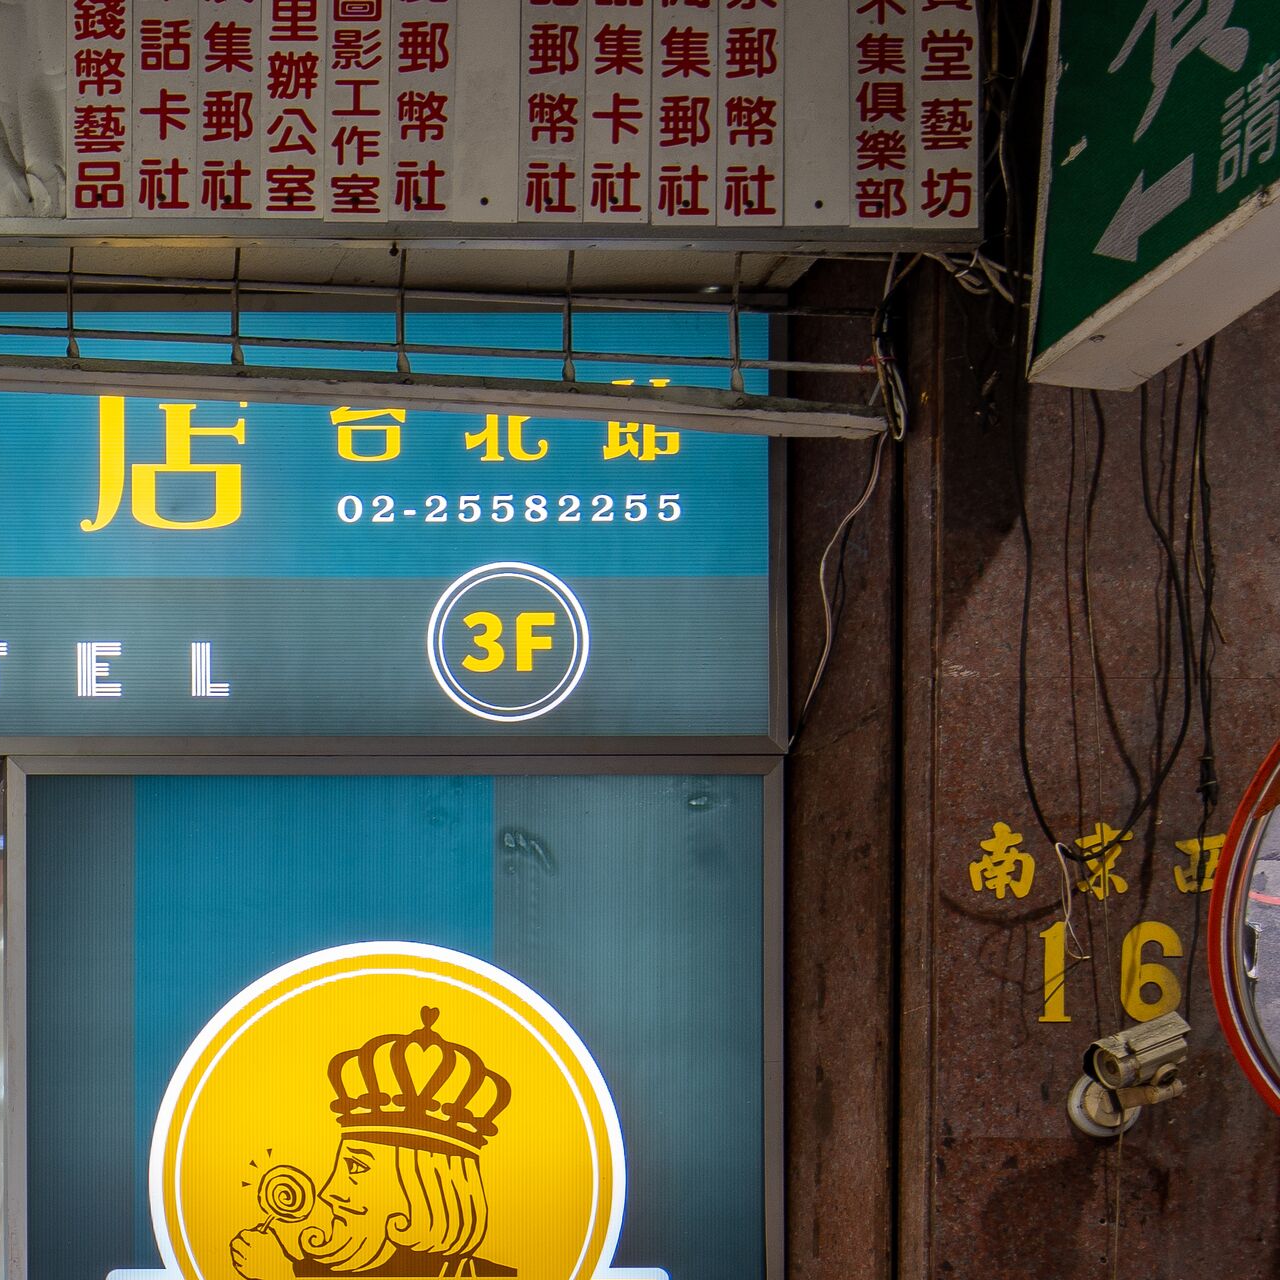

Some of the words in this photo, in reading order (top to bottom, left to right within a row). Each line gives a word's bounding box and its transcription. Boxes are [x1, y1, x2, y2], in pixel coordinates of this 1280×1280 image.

[74, 0, 126, 209] 錢幣藝品
[139, 0, 192, 211] 話卡社
[202, 0, 254, 212] 集郵社
[394, 0, 450, 213] 郵幣社
[526, 0, 580, 214] 郵幣社
[590, 0, 644, 214] 集卡社
[658, 0, 712, 217] 集郵社
[724, 0, 778, 217] 郵幣社
[920, 0, 974, 219] 堂藝坊
[337, 494, 683, 523] 02-25582255
[461, 611, 556, 673] 3F
